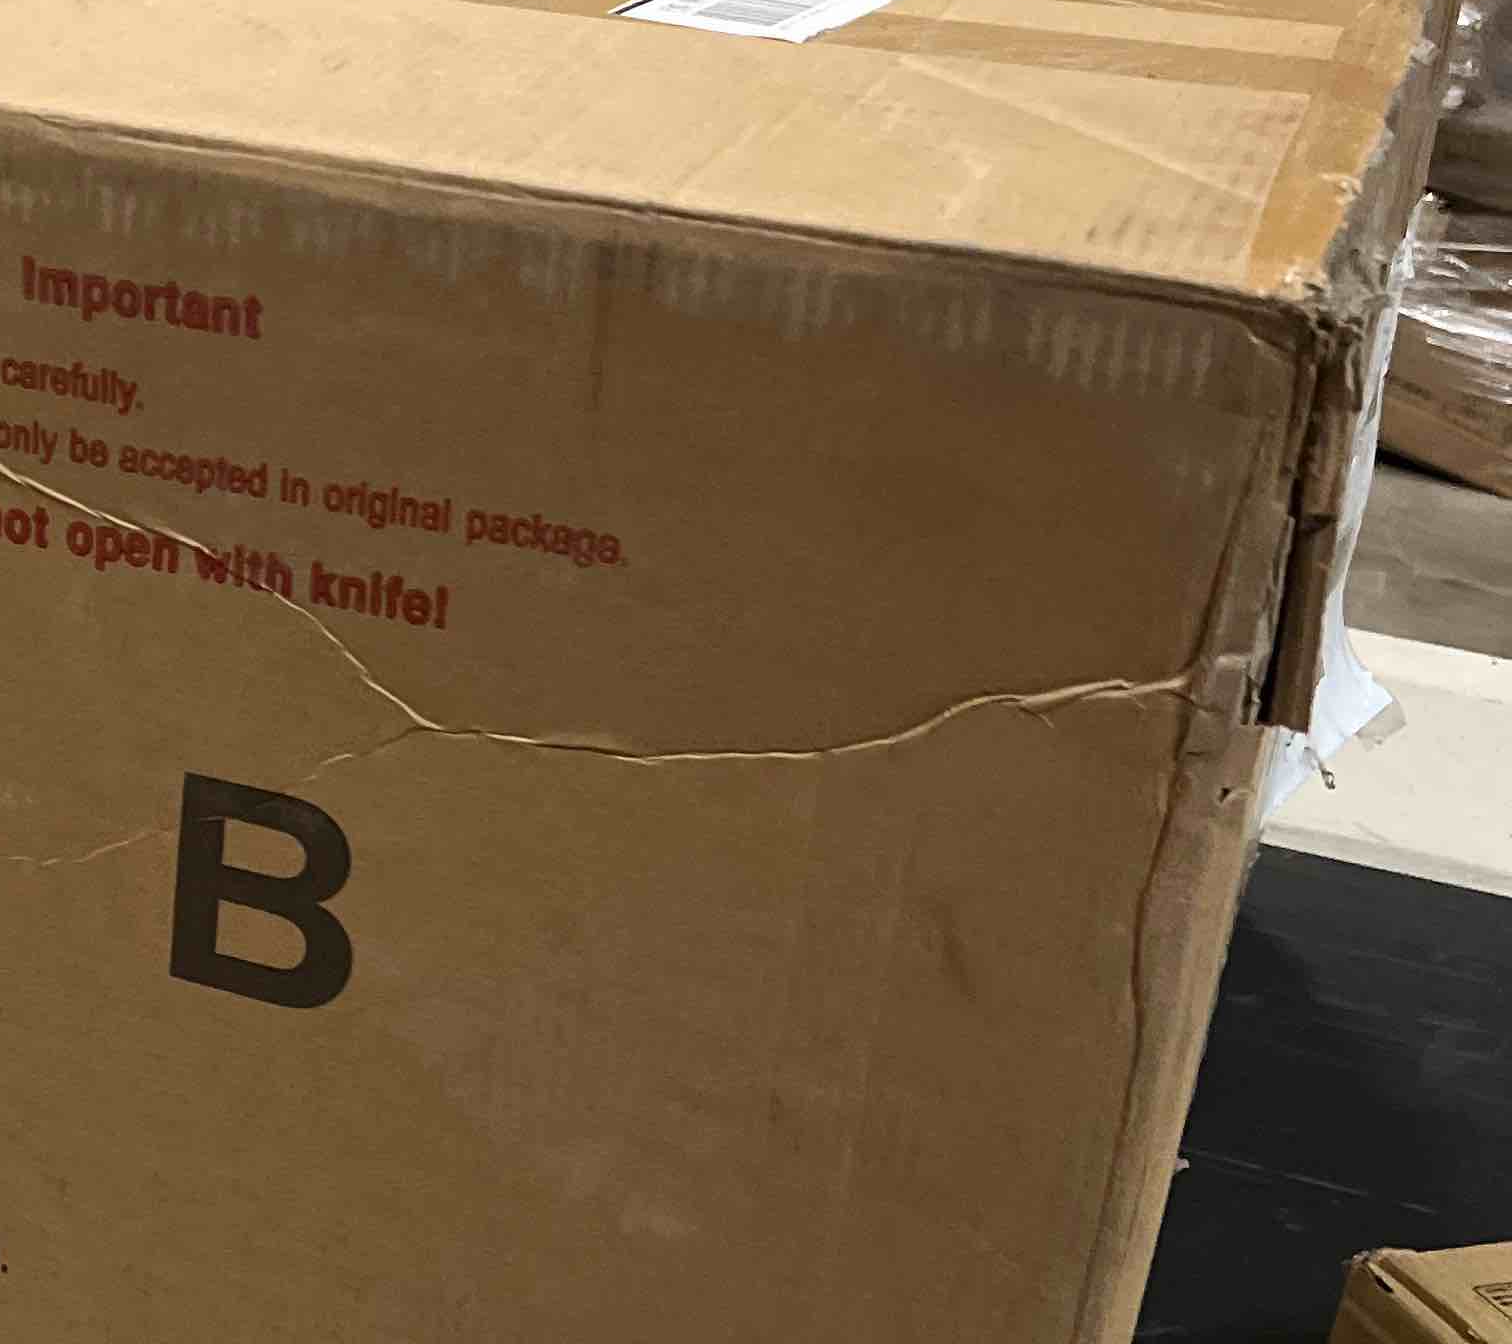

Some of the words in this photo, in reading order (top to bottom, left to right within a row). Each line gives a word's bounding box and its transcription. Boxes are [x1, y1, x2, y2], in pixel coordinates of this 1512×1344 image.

[22, 256, 264, 339] Important
[1, 357, 144, 416] carefully.
[69, 428, 110, 467] be
[119, 445, 269, 499] accepted
[280, 467, 311, 507] in
[323, 481, 452, 530] original
[464, 508, 629, 568] package.
[66, 520, 179, 574] open
[193, 539, 295, 599] with
[310, 561, 449, 630] knife!
[170, 771, 352, 1008] B
